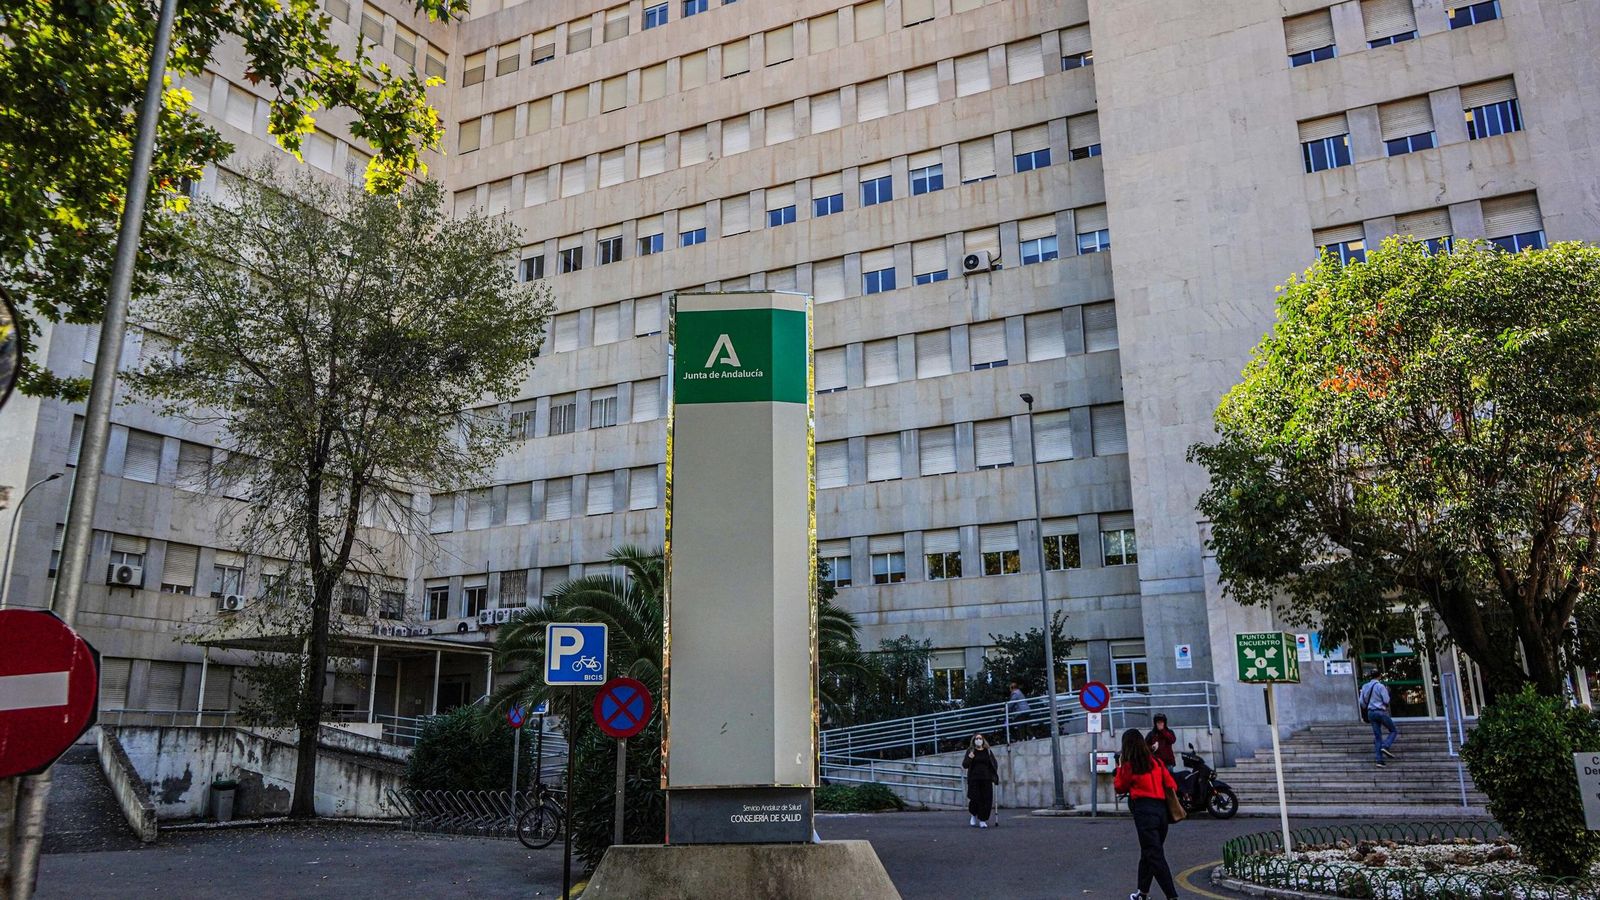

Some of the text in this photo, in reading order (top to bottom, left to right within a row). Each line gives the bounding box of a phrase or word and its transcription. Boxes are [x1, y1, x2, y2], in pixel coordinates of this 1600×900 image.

[708, 370, 720, 379] de
[720, 368, 764, 378] Andalucía
[551, 628, 584, 670] P
[743, 804, 760, 812] Servicio
[760, 803, 781, 811] Andaluz
[788, 803, 802, 811] Salud
[730, 812, 802, 823] CONSEJERÍA DE SALUD
